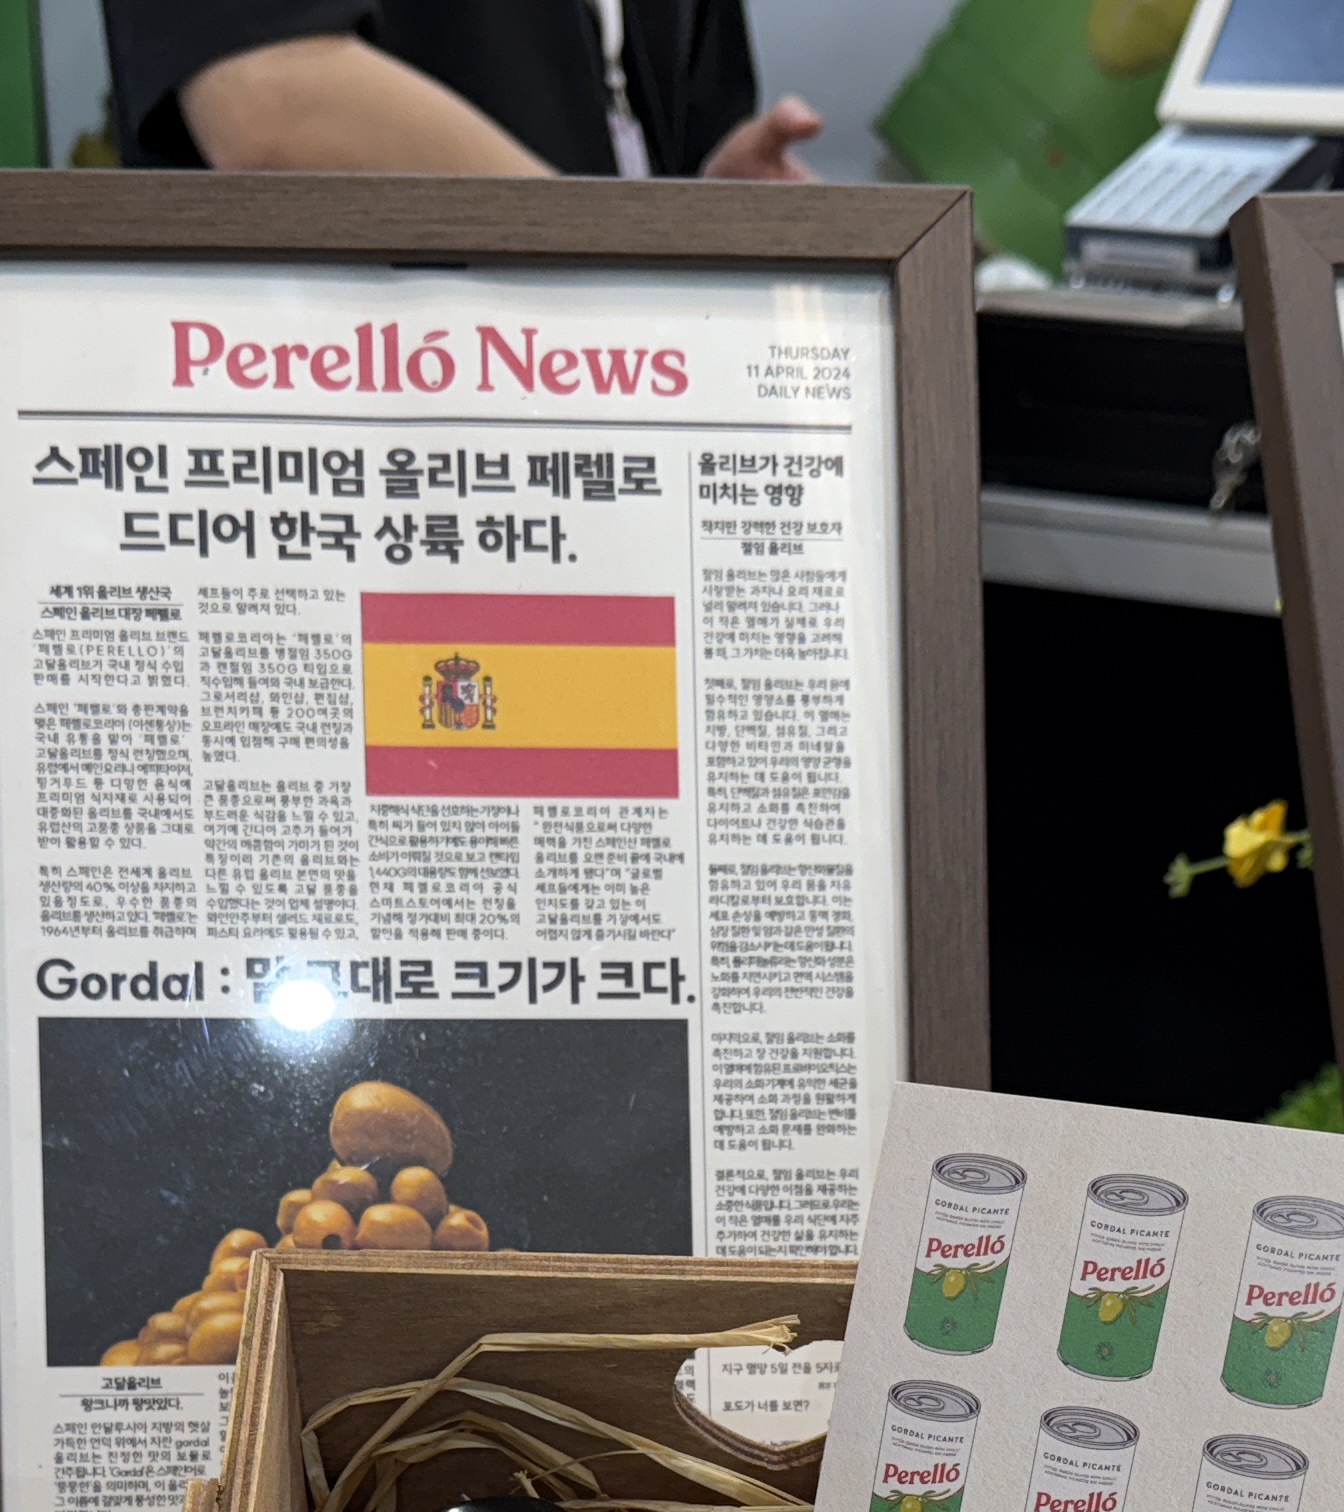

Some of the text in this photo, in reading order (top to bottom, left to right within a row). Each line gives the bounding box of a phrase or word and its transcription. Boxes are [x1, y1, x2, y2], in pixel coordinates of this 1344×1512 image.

[170, 319, 688, 397] Perelló News
[768, 346, 850, 360] THURSDAY
[747, 366, 851, 380] 11 APRIL 2024
[757, 385, 851, 400] DAILY NEWS
[32, 443, 662, 502] 스페인 프리미엄 올리브 페렐로
[698, 452, 843, 478] 올리브가 건강에
[699, 483, 804, 507] 미치는 영향
[119, 509, 578, 565] 드디어 한국 상륙 하다.
[37, 959, 204, 1001] Gordal
[451, 957, 585, 1004] 크기가
[597, 957, 696, 1004] 크다.
[925, 1235, 1005, 1259] Perelló
[1080, 1257, 1166, 1283] Perelló
[1245, 1282, 1336, 1307] Perelló
[101, 1377, 162, 1389] 고달올리브
[882, 1462, 961, 1485] Perelló
